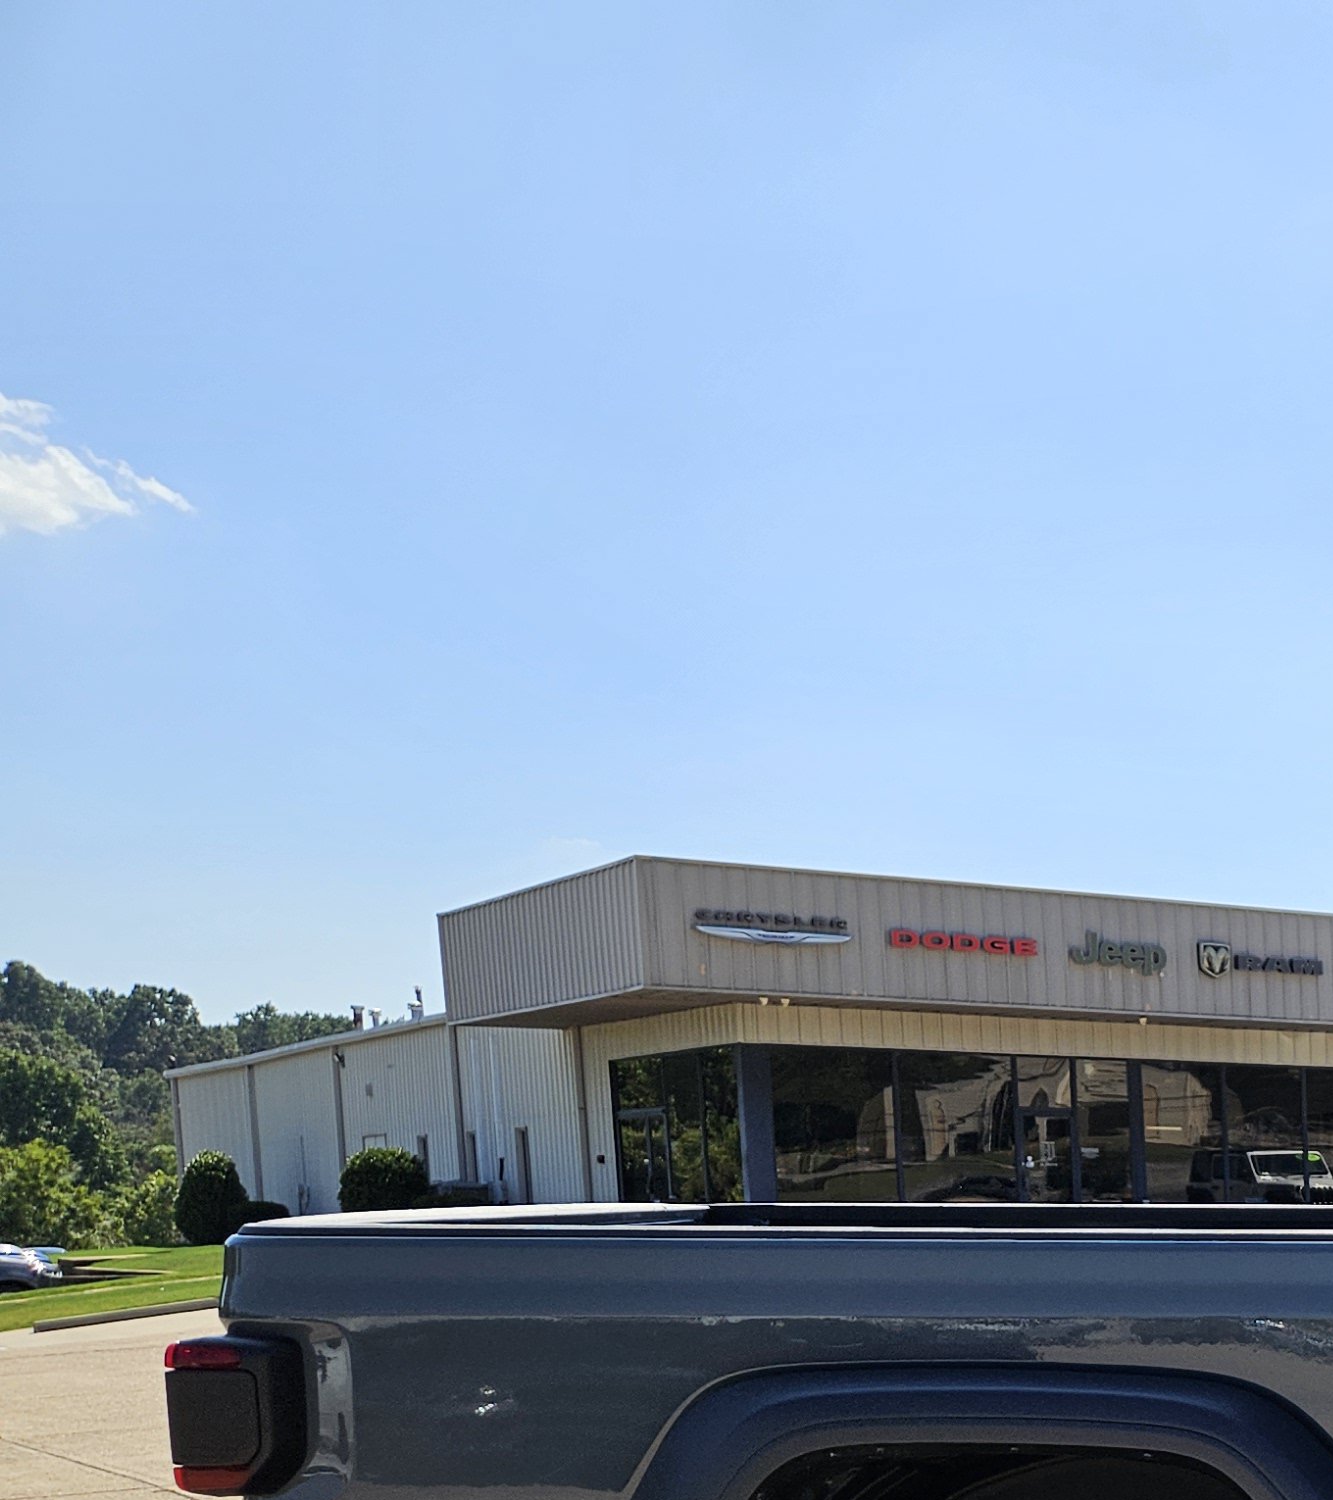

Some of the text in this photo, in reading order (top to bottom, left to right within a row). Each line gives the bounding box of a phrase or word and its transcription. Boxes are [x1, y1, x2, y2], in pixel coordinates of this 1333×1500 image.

[694, 907, 849, 931] CHRYSLER
[890, 928, 1038, 957] DODGE
[1069, 929, 1168, 977] Jeep
[1233, 951, 1324, 976] RAM
